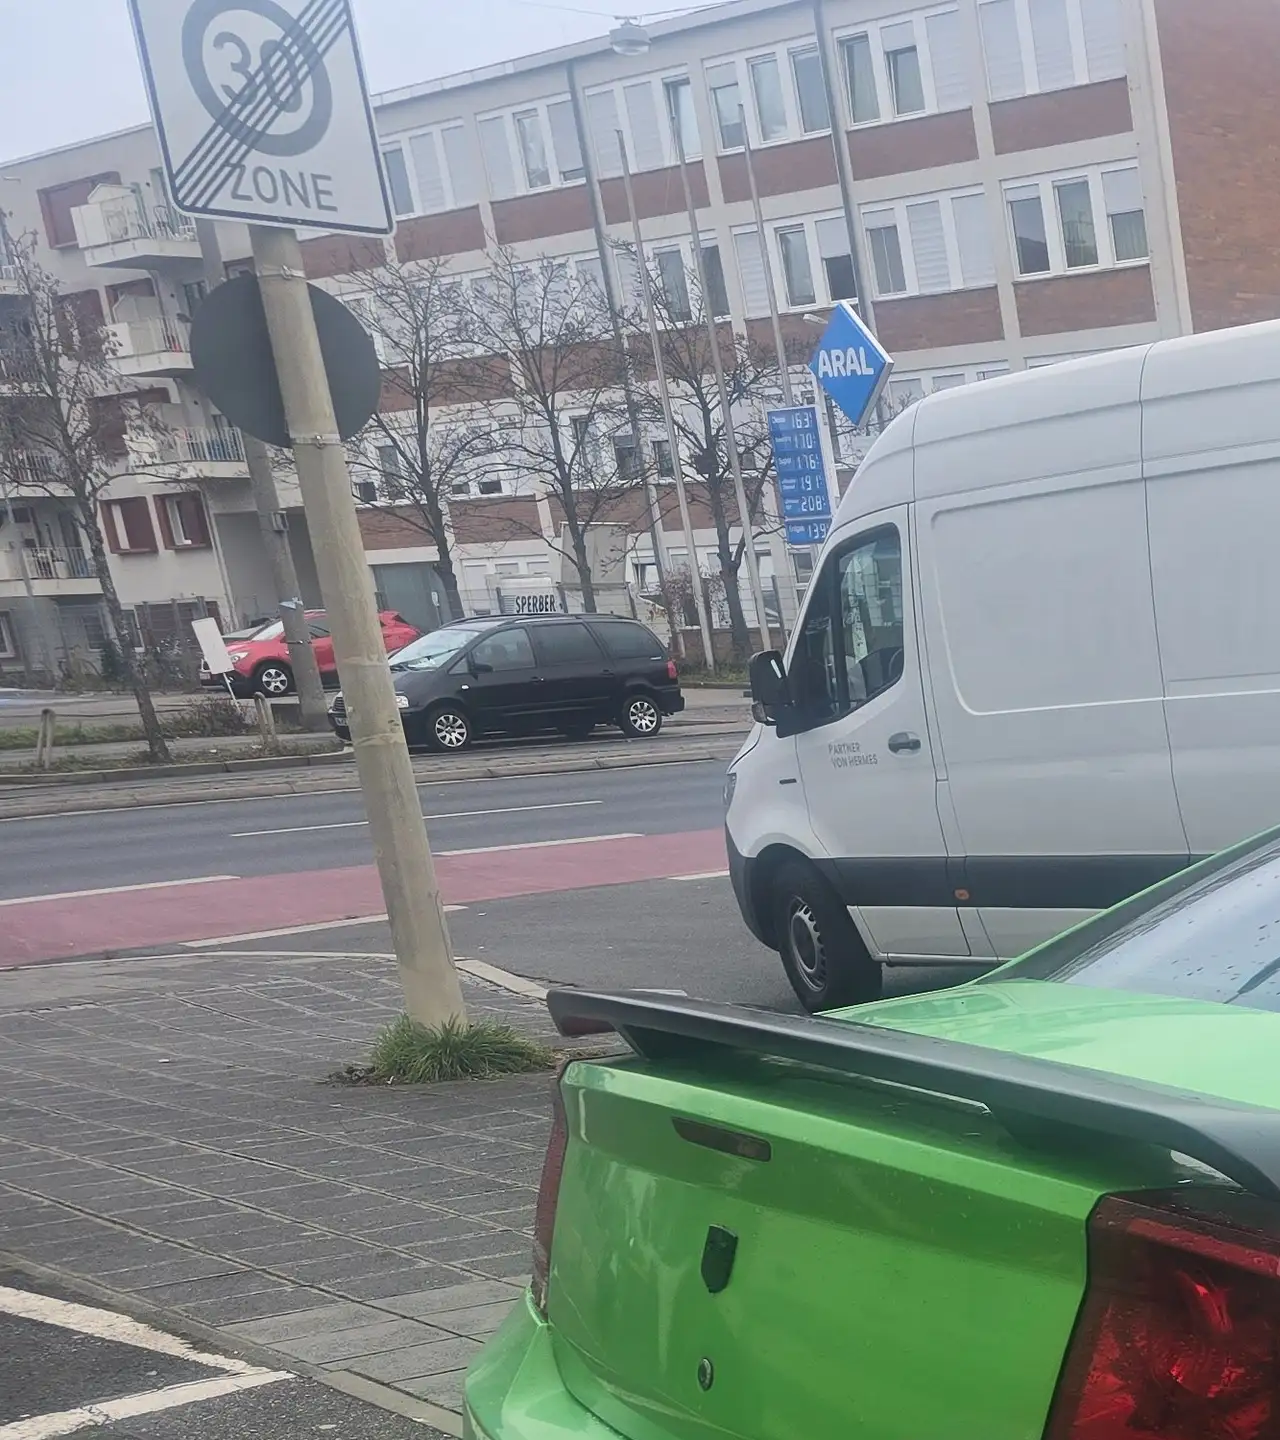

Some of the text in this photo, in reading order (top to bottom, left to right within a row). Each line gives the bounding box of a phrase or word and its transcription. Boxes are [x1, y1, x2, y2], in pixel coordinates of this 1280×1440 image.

[223, 163, 339, 213] ZONE
[818, 346, 875, 379] ARAL
[515, 594, 556, 613] SPERBER
[828, 742, 861, 754] PARTNER
[848, 754, 878, 766] HERMES
